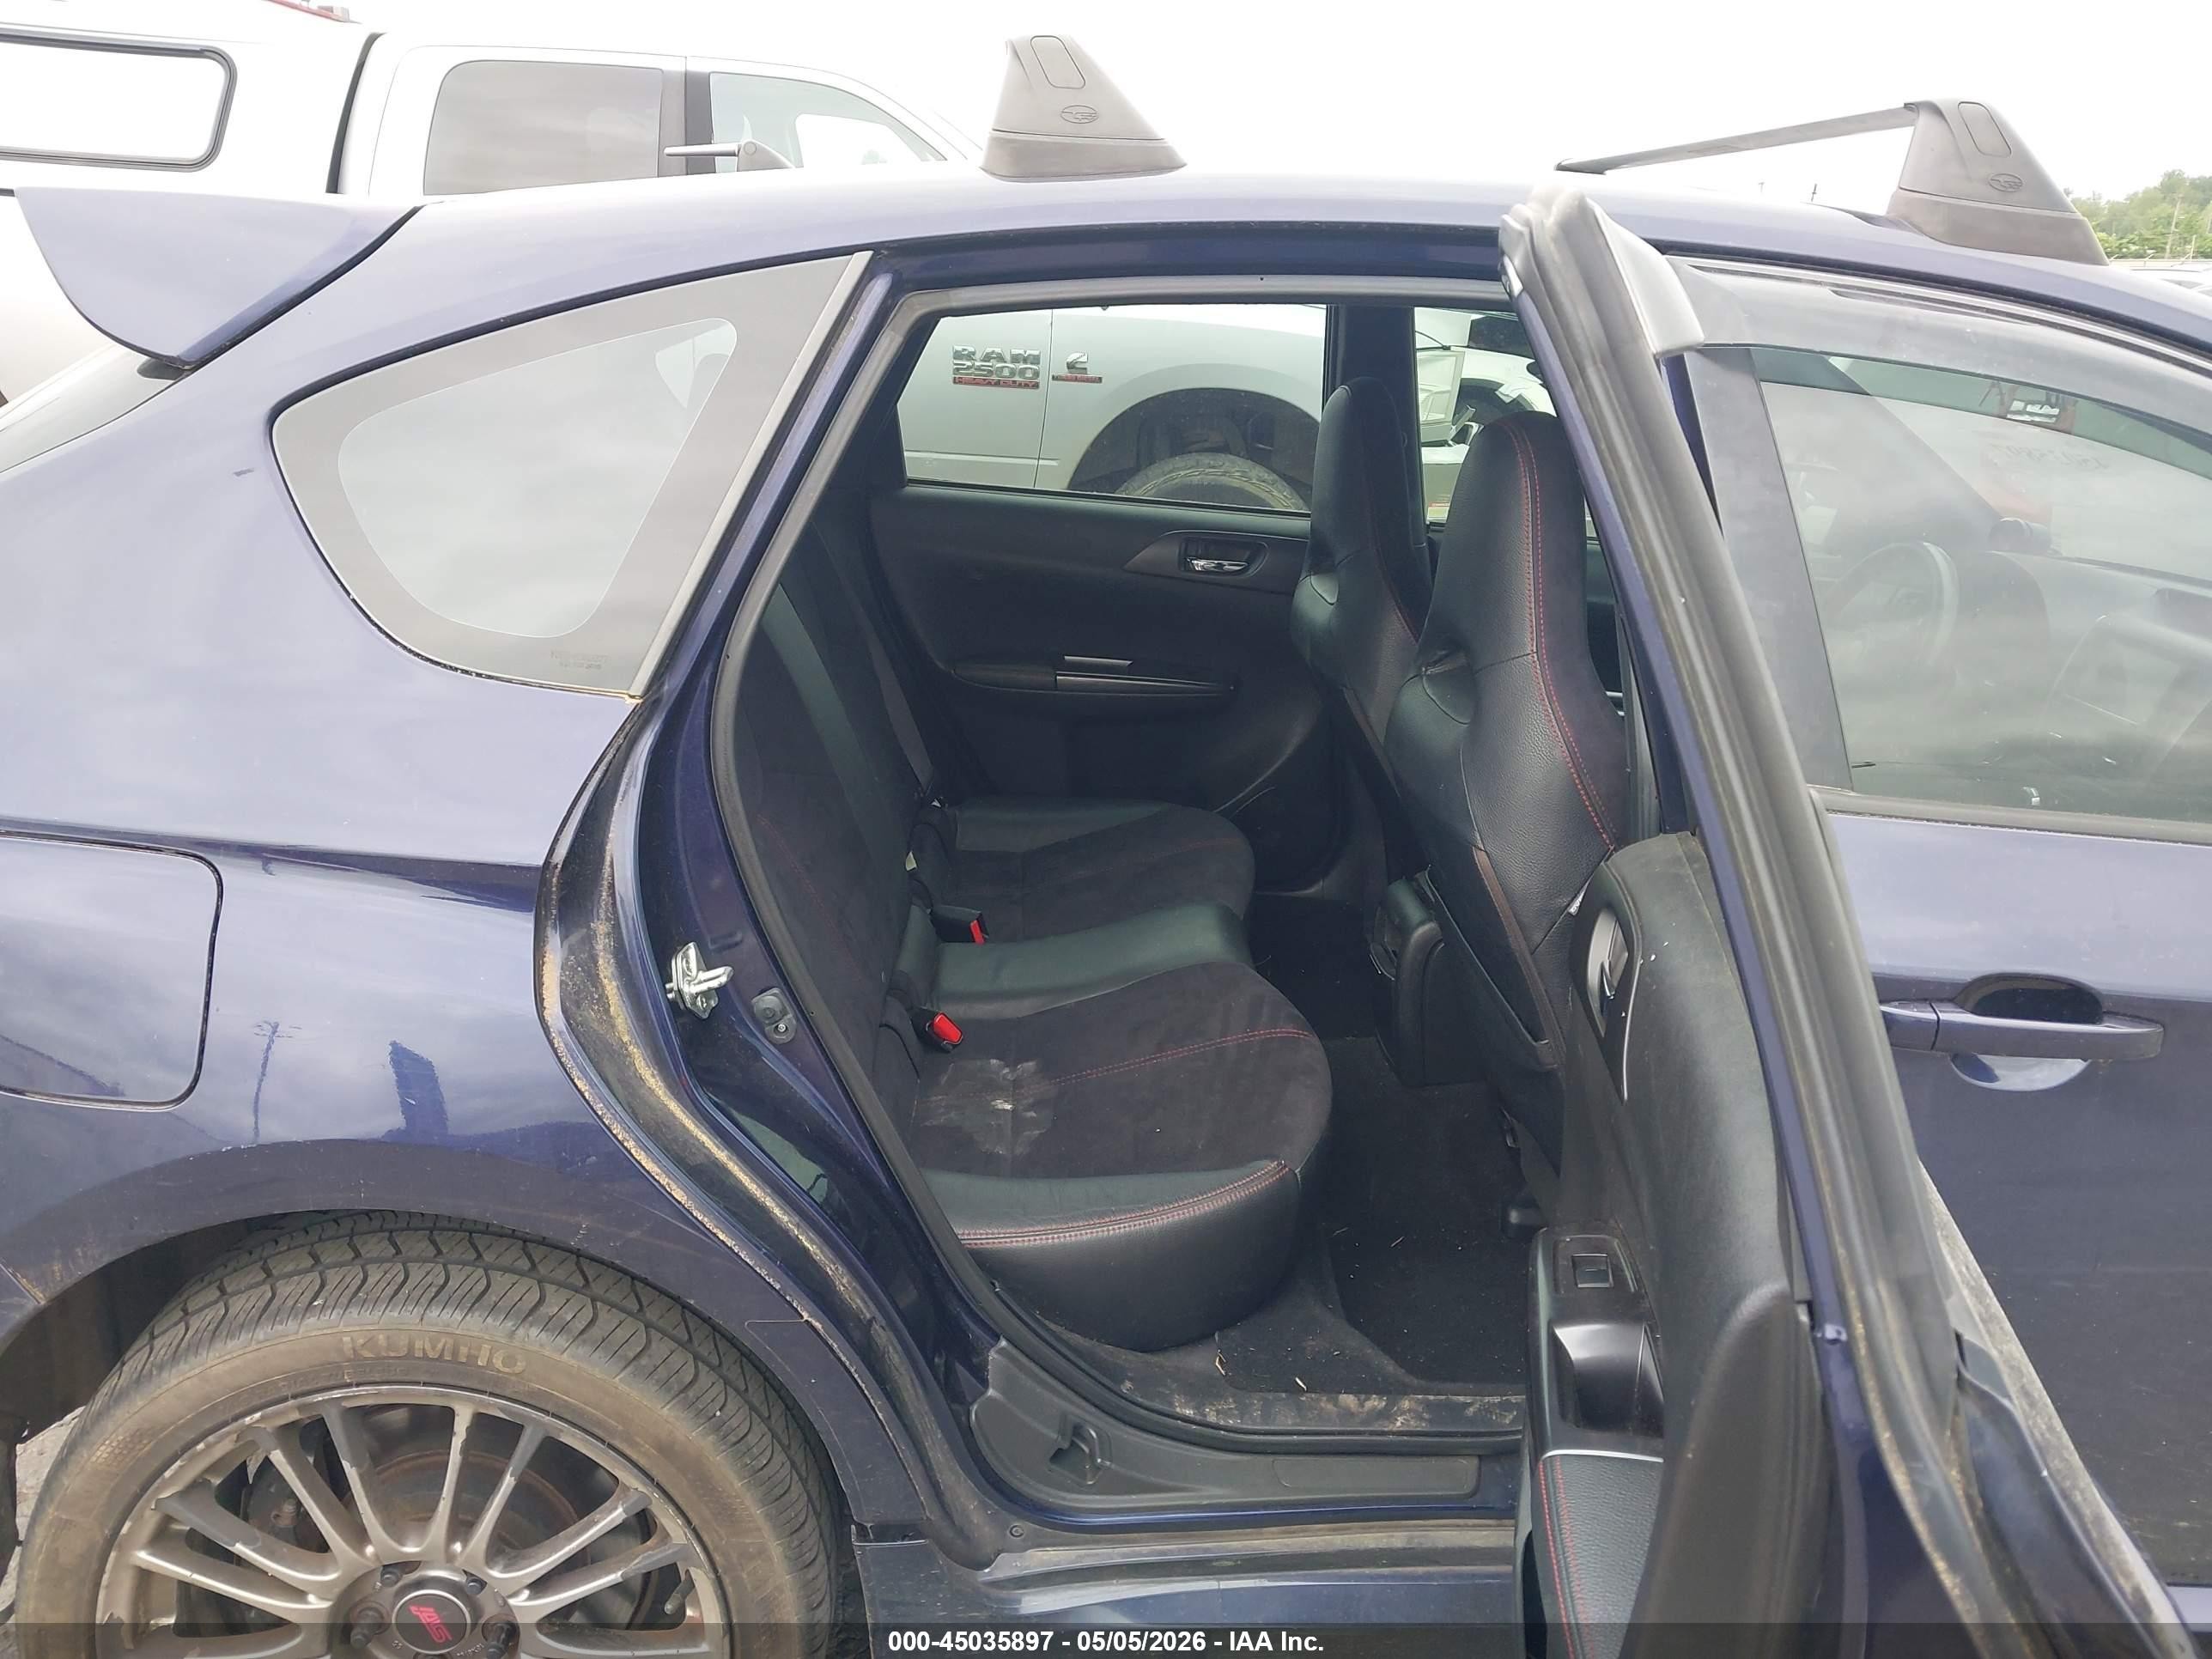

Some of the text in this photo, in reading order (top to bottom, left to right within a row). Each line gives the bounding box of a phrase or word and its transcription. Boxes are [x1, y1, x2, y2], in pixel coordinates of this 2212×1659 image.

[952, 345, 1041, 364] RAM
[952, 360, 1040, 380] 2500
[955, 377, 1038, 388] HEAVY DUTY
[343, 1334, 526, 1375] KUMHO
